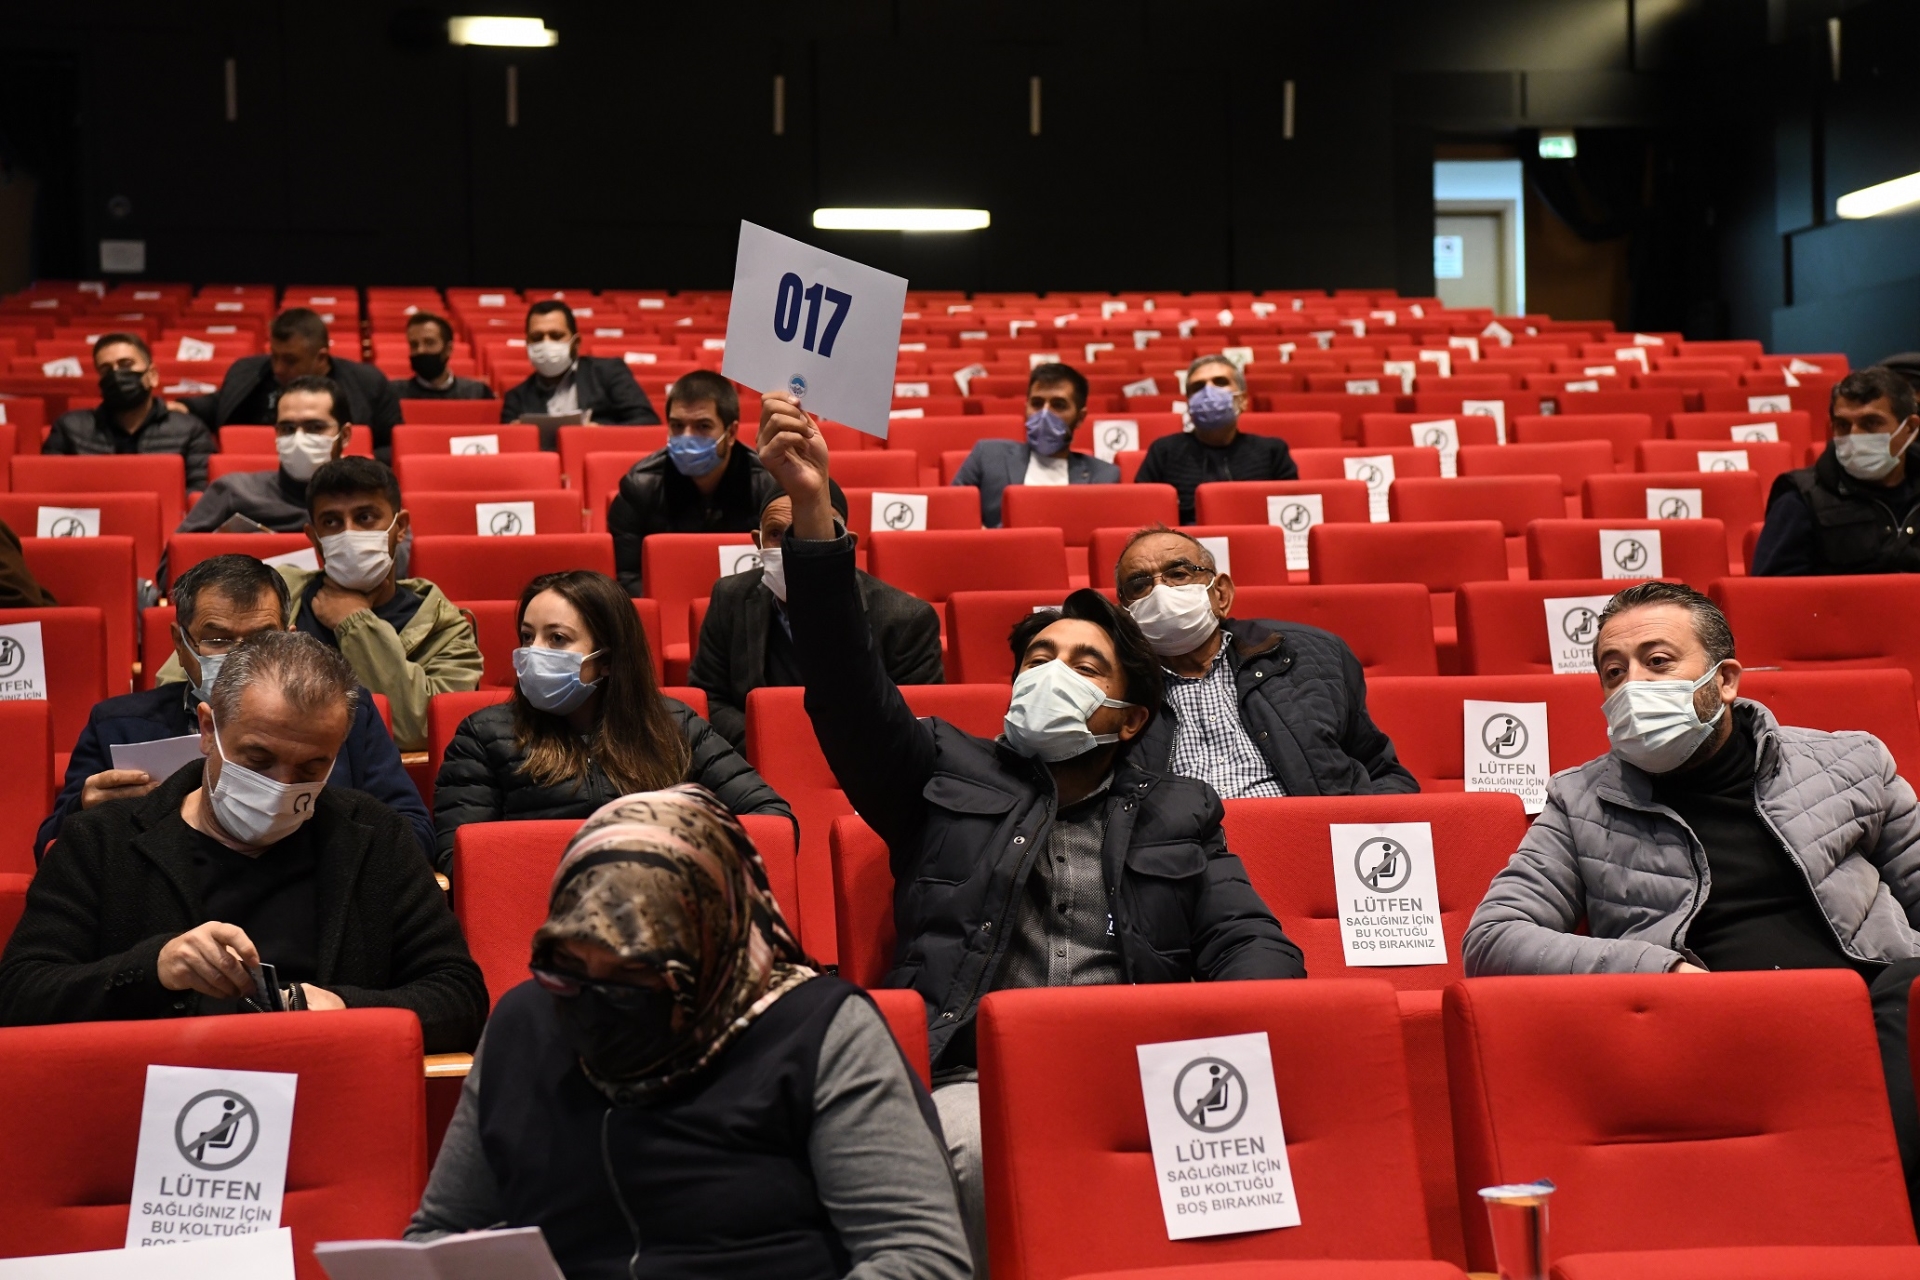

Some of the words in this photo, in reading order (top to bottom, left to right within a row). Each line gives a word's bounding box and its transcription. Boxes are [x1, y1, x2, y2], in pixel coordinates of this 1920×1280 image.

[773, 272, 853, 358] 017
[1563, 647, 1593, 659] LÜTF
[0, 679, 33, 692] TFEN
[1479, 760, 1536, 775] LÜTFEN
[1471, 776, 1524, 786] SAĞLIĞINIZ
[1526, 777, 1545, 788] İÇİN
[1353, 896, 1423, 913] LÜTFEN
[1346, 914, 1410, 927] SAĞLIĞINIZ
[1412, 913, 1435, 926] İÇİN
[1355, 928, 1371, 938] BU
[1374, 926, 1428, 938] KOLTUĞU
[1352, 940, 1376, 951] BOŞ
[1379, 939, 1436, 949] BIRAKINIZ
[1176, 1136, 1266, 1163] LÜTFEN
[1167, 1163, 1250, 1183] SAĞLIĞINIZ
[1252, 1158, 1282, 1175] İÇİN
[159, 1174, 262, 1201] LÜTFEN
[1180, 1185, 1201, 1198] BU
[1204, 1176, 1274, 1195] KOLTUĞU
[1176, 1202, 1208, 1215] BOŞ
[1212, 1193, 1285, 1211] BIRAKINIZ
[141, 1201, 236, 1220] SAĞLIĞINIZ
[239, 1204, 272, 1224] İÇİN
[151, 1220, 174, 1234] BU
